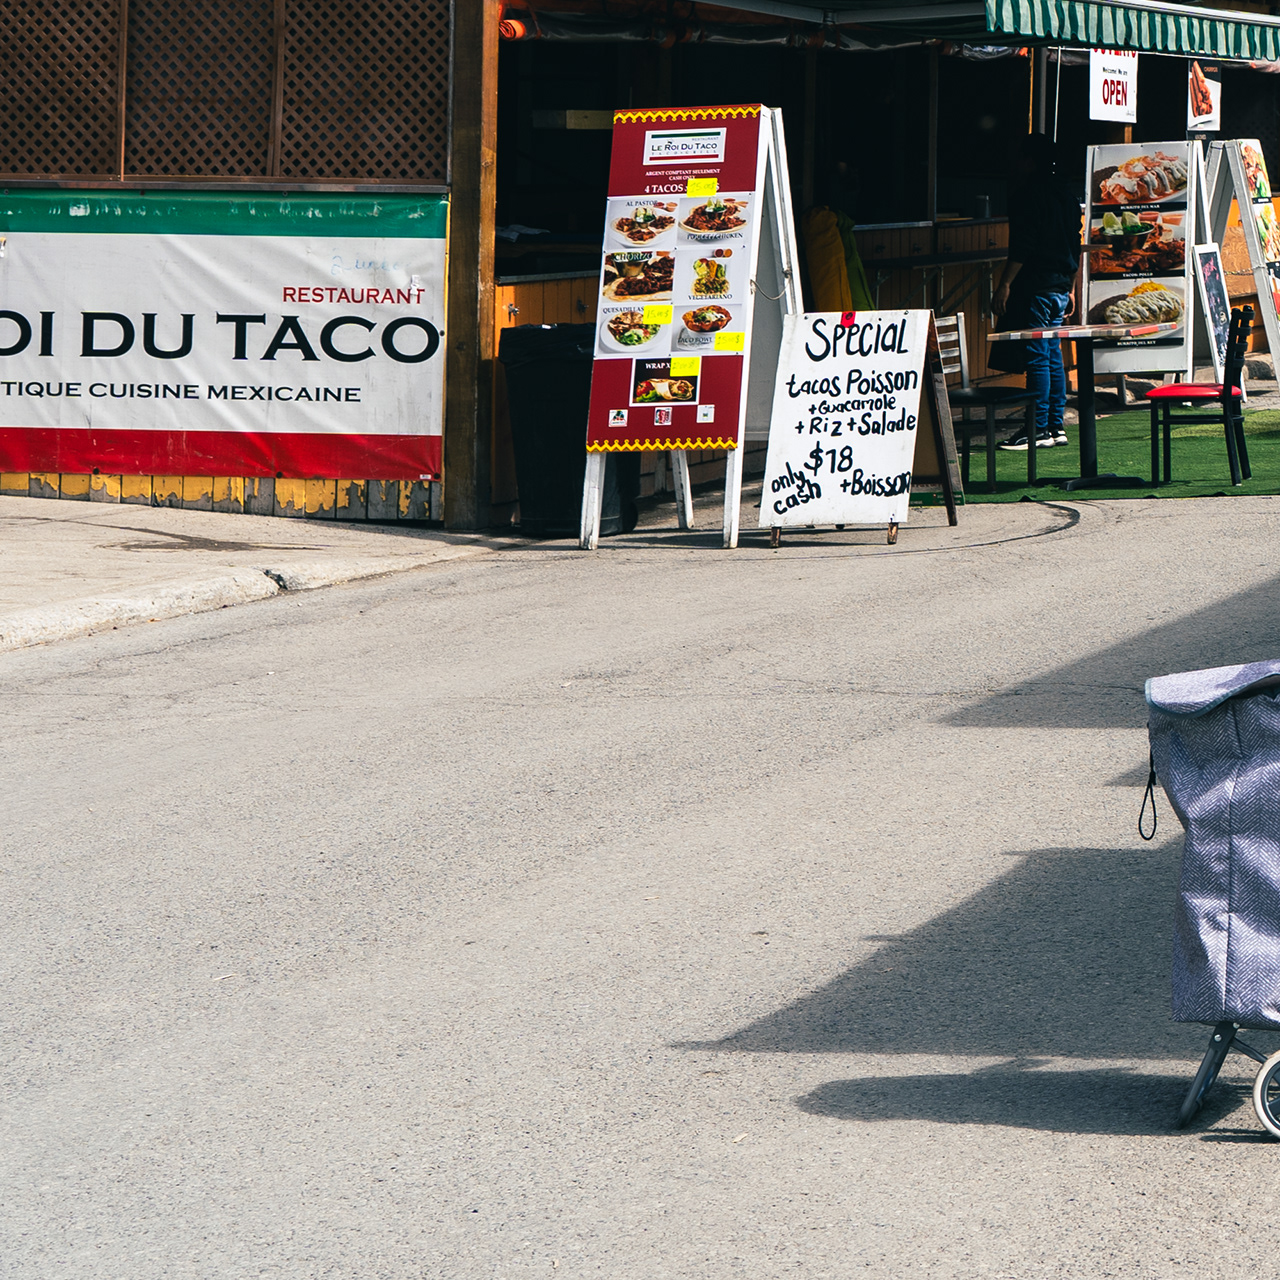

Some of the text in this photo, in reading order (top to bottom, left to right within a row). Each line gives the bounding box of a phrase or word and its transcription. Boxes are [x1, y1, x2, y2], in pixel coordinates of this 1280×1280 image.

[1102, 78, 1128, 107] OPEN
[651, 183, 684, 193] TACOS
[282, 287, 426, 305] RESTAURANT
[80, 311, 195, 359] DU
[216, 311, 440, 364] TACO
[89, 381, 200, 400] CUISINE
[207, 385, 361, 403] MEXICAINE
[786, 369, 918, 398] tacos Poisson
[809, 417, 843, 437] Riz
[804, 441, 853, 477] $18
[772, 461, 806, 493] only
[774, 480, 822, 515] cash
